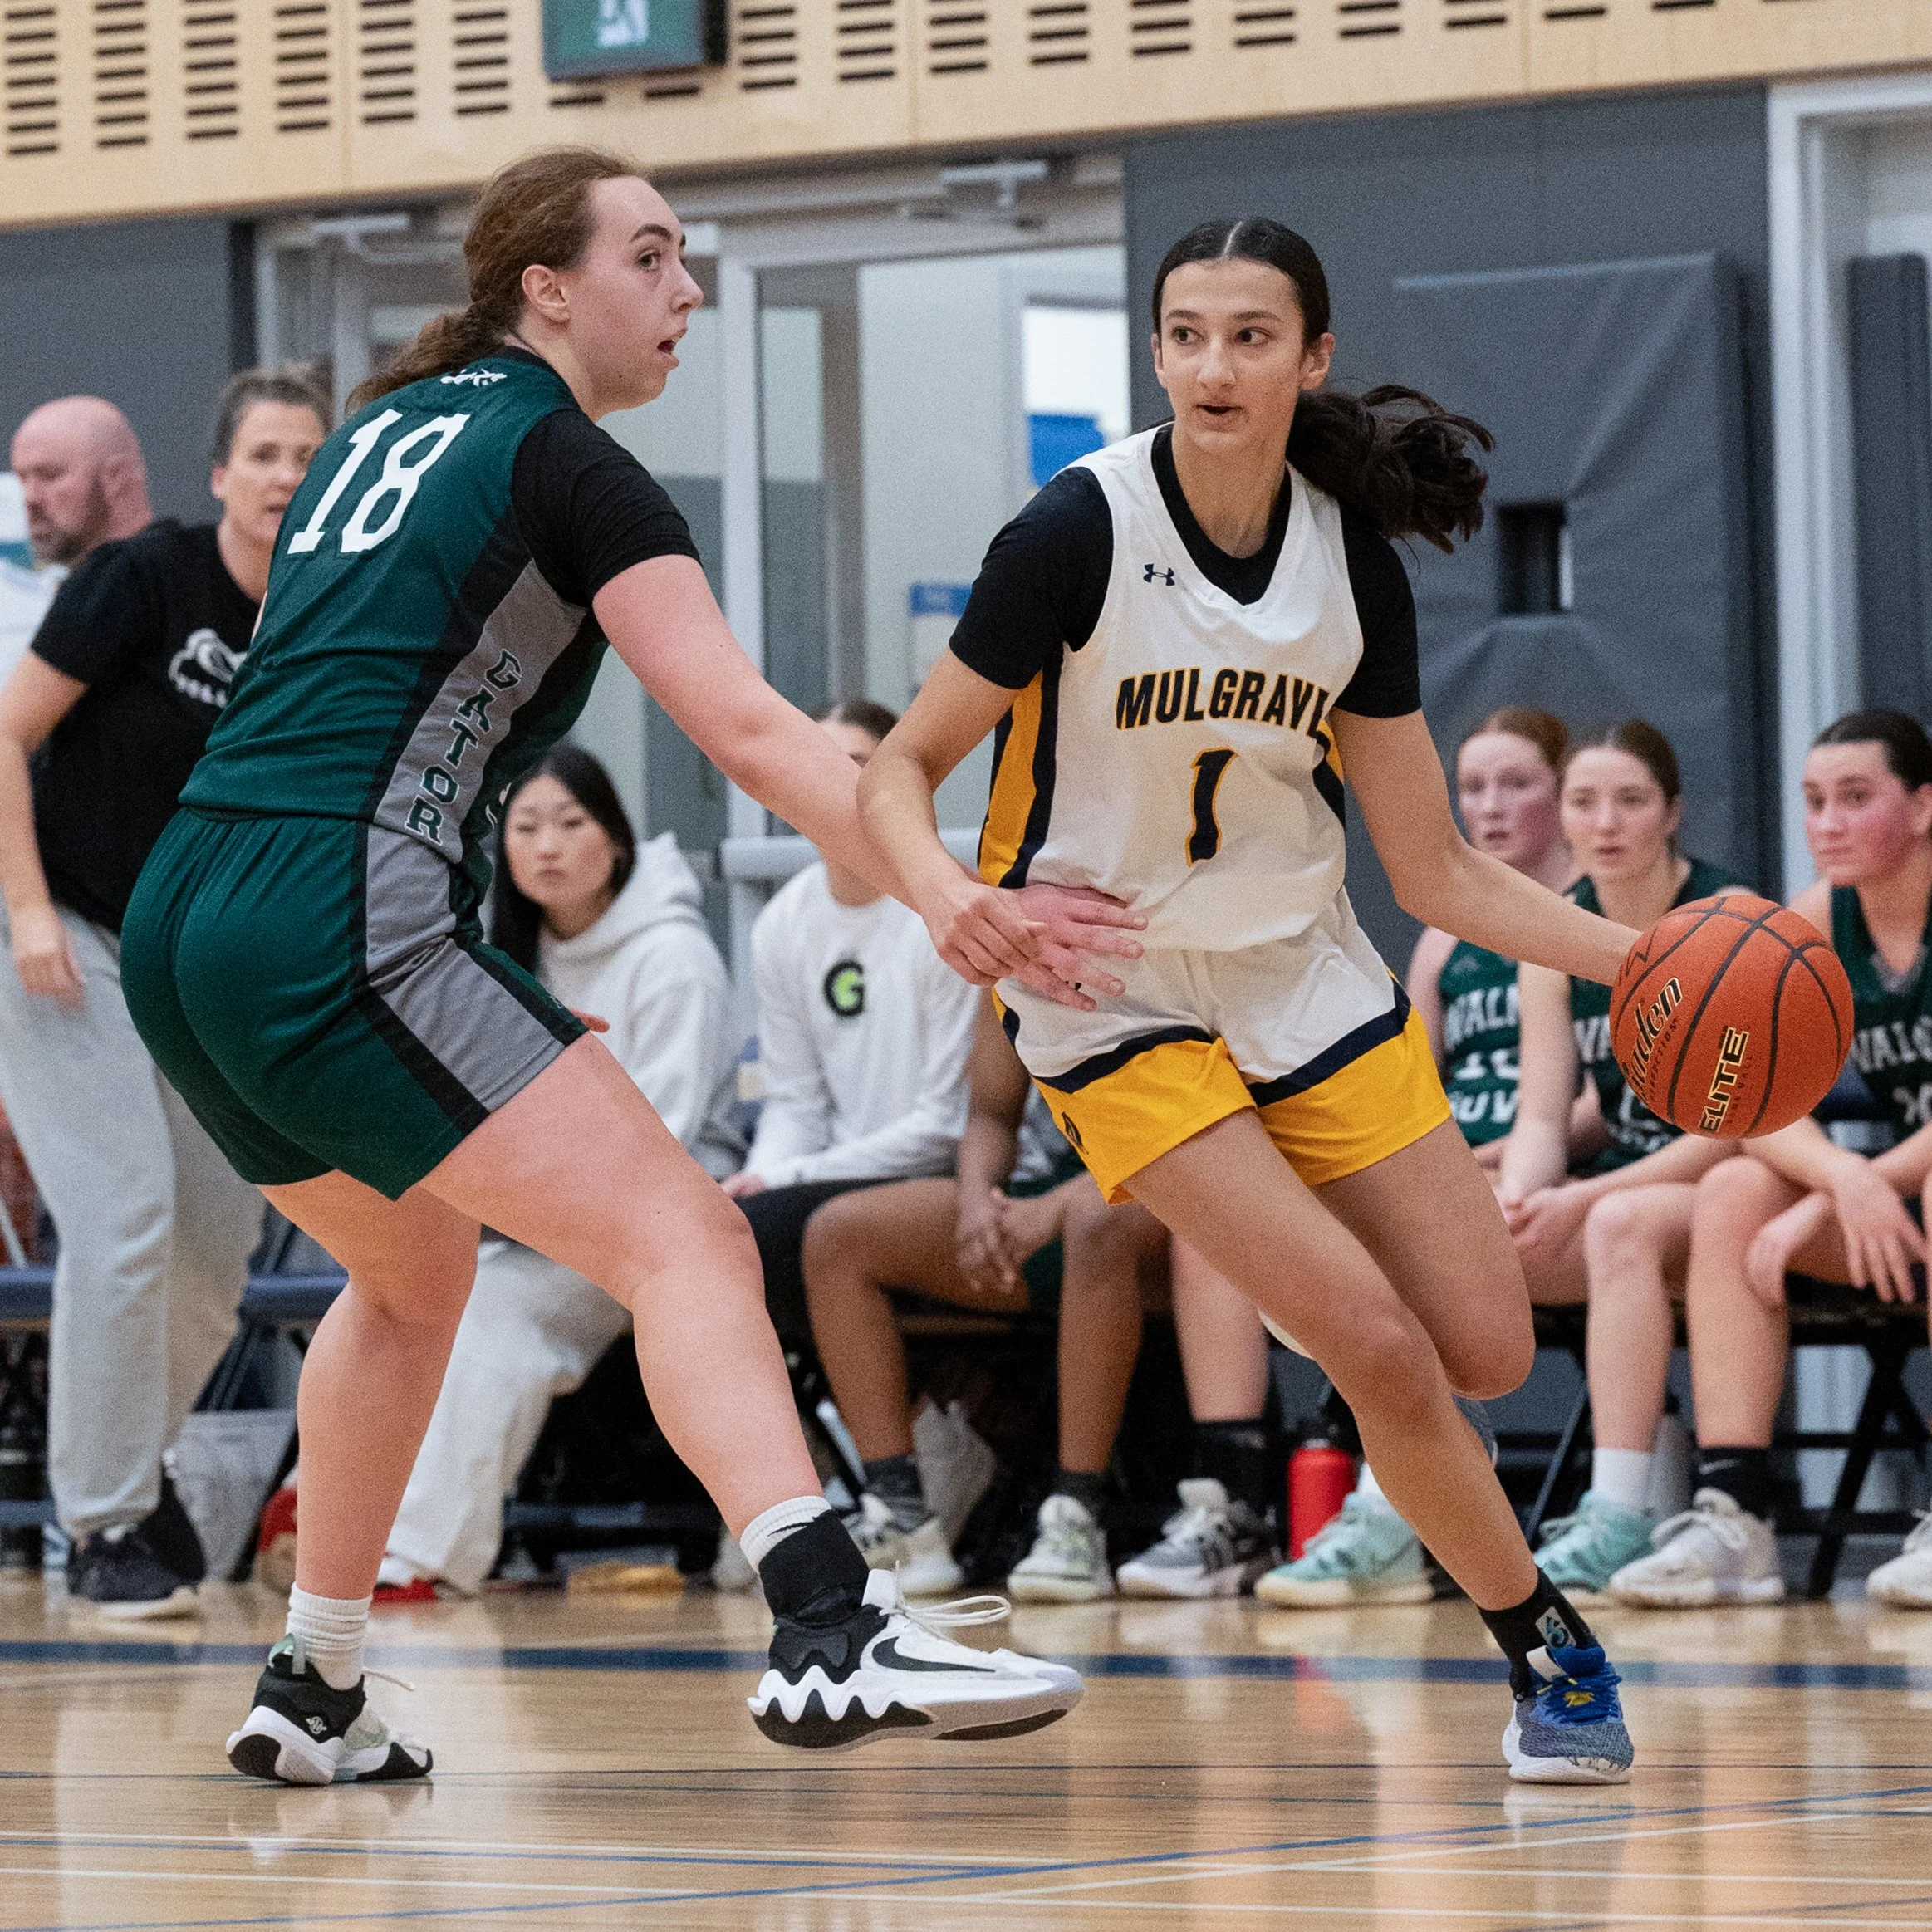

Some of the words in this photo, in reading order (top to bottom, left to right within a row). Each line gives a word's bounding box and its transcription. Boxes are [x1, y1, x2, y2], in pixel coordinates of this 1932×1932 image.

[287, 408, 471, 554] 18
[405, 649, 522, 846] GATOR
[1184, 746, 1239, 868] 1
[823, 959, 865, 1018] G
[1698, 1026, 1749, 1132] ELITE
